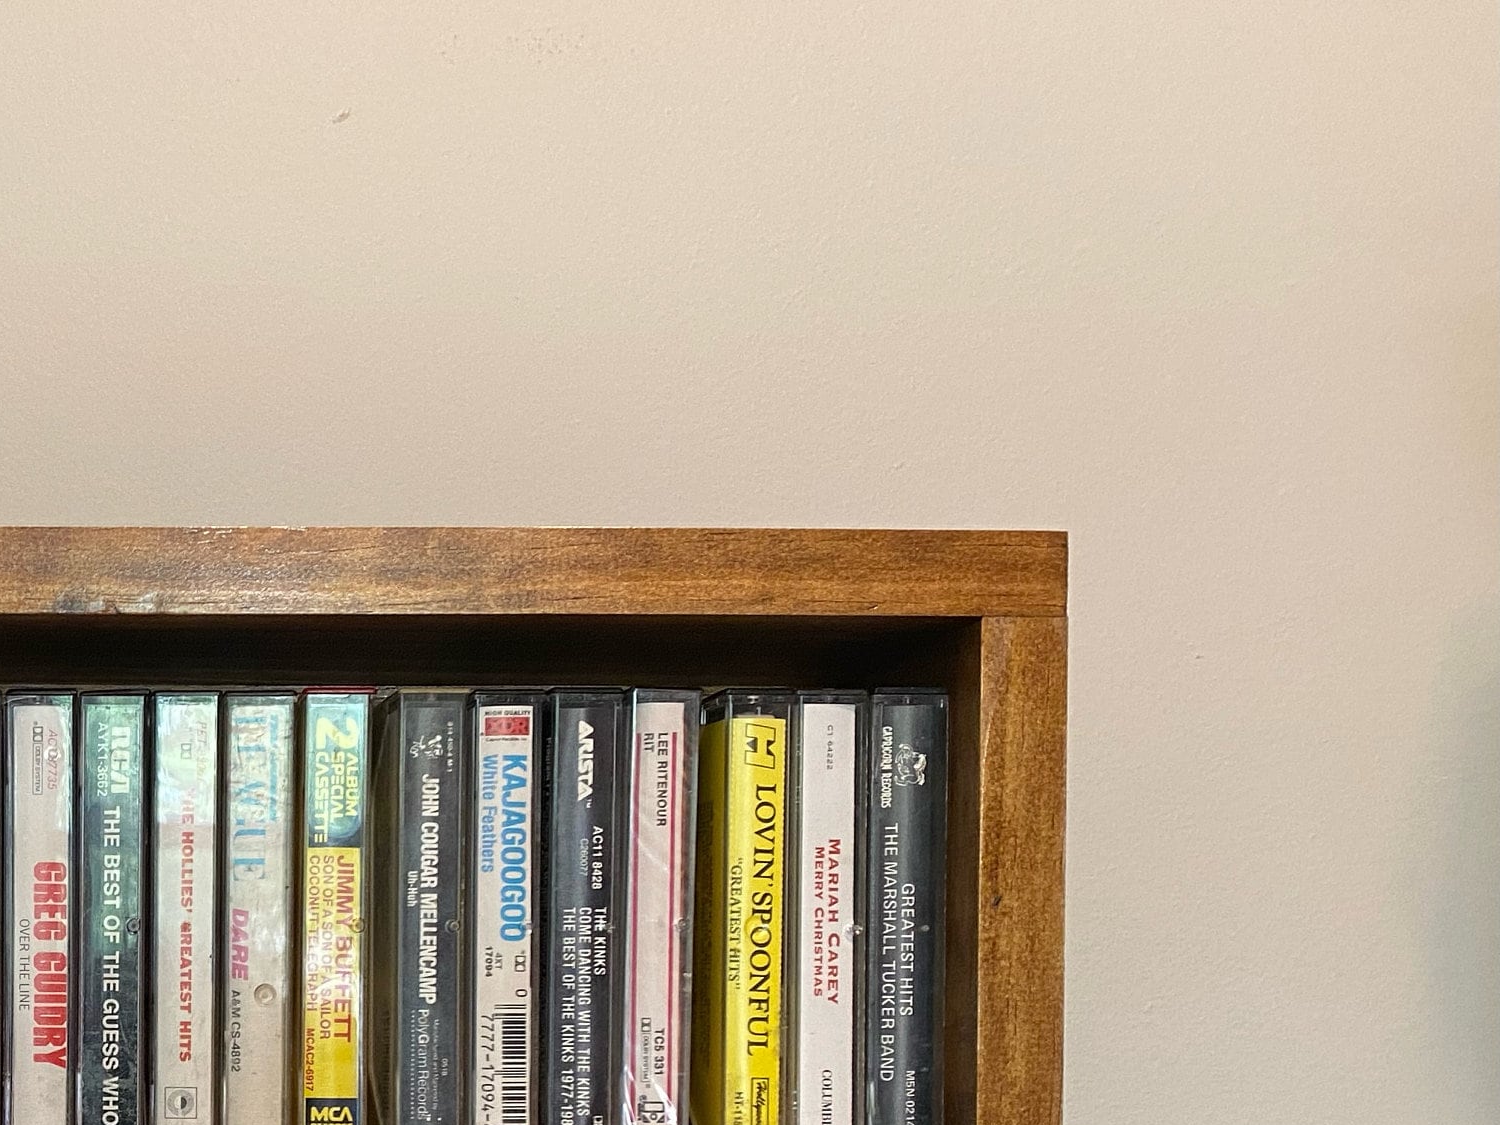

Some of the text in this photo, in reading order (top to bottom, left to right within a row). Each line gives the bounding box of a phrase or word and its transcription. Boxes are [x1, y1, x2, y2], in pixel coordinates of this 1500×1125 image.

[97, 722, 107, 796] AYK1-3662
[644, 733, 655, 753] RIT
[656, 733, 667, 826] LEE RITENOUR
[103, 806, 120, 846] THE
[421, 774, 439, 816] JOHN
[481, 754, 497, 872] White Feathers
[103, 854, 120, 907] BEST
[420, 822, 438, 887] COUGAR
[500, 754, 527, 941] KAJAGOOGOO
[103, 915, 120, 943] OF
[232, 909, 248, 982] DARE
[333, 856, 352, 1042] JIMMY BUFFETT
[418, 893, 438, 1004] MELLENCAMP
[594, 907, 607, 975] THE KINKS
[748, 784, 776, 1056] LOVIN' SPOONFUL
[813, 847, 824, 997] MERRY CHRISTMAS
[827, 838, 840, 1005] MARIAH CAREY
[880, 823, 898, 1081] THE MARSHALL TUCKER BAND
[18, 919, 30, 1010] OVER THE LINE
[33, 862, 66, 1068] GREG GUIDRY
[103, 951, 120, 991] THE
[485, 946, 493, 977] 17094
[103, 999, 119, 1070] GUESS
[576, 907, 591, 1116] COME DANCING WITH THE KINKS
[305, 1028, 315, 1091] MCAC2-6917
[310, 1107, 350, 1122] MCA
